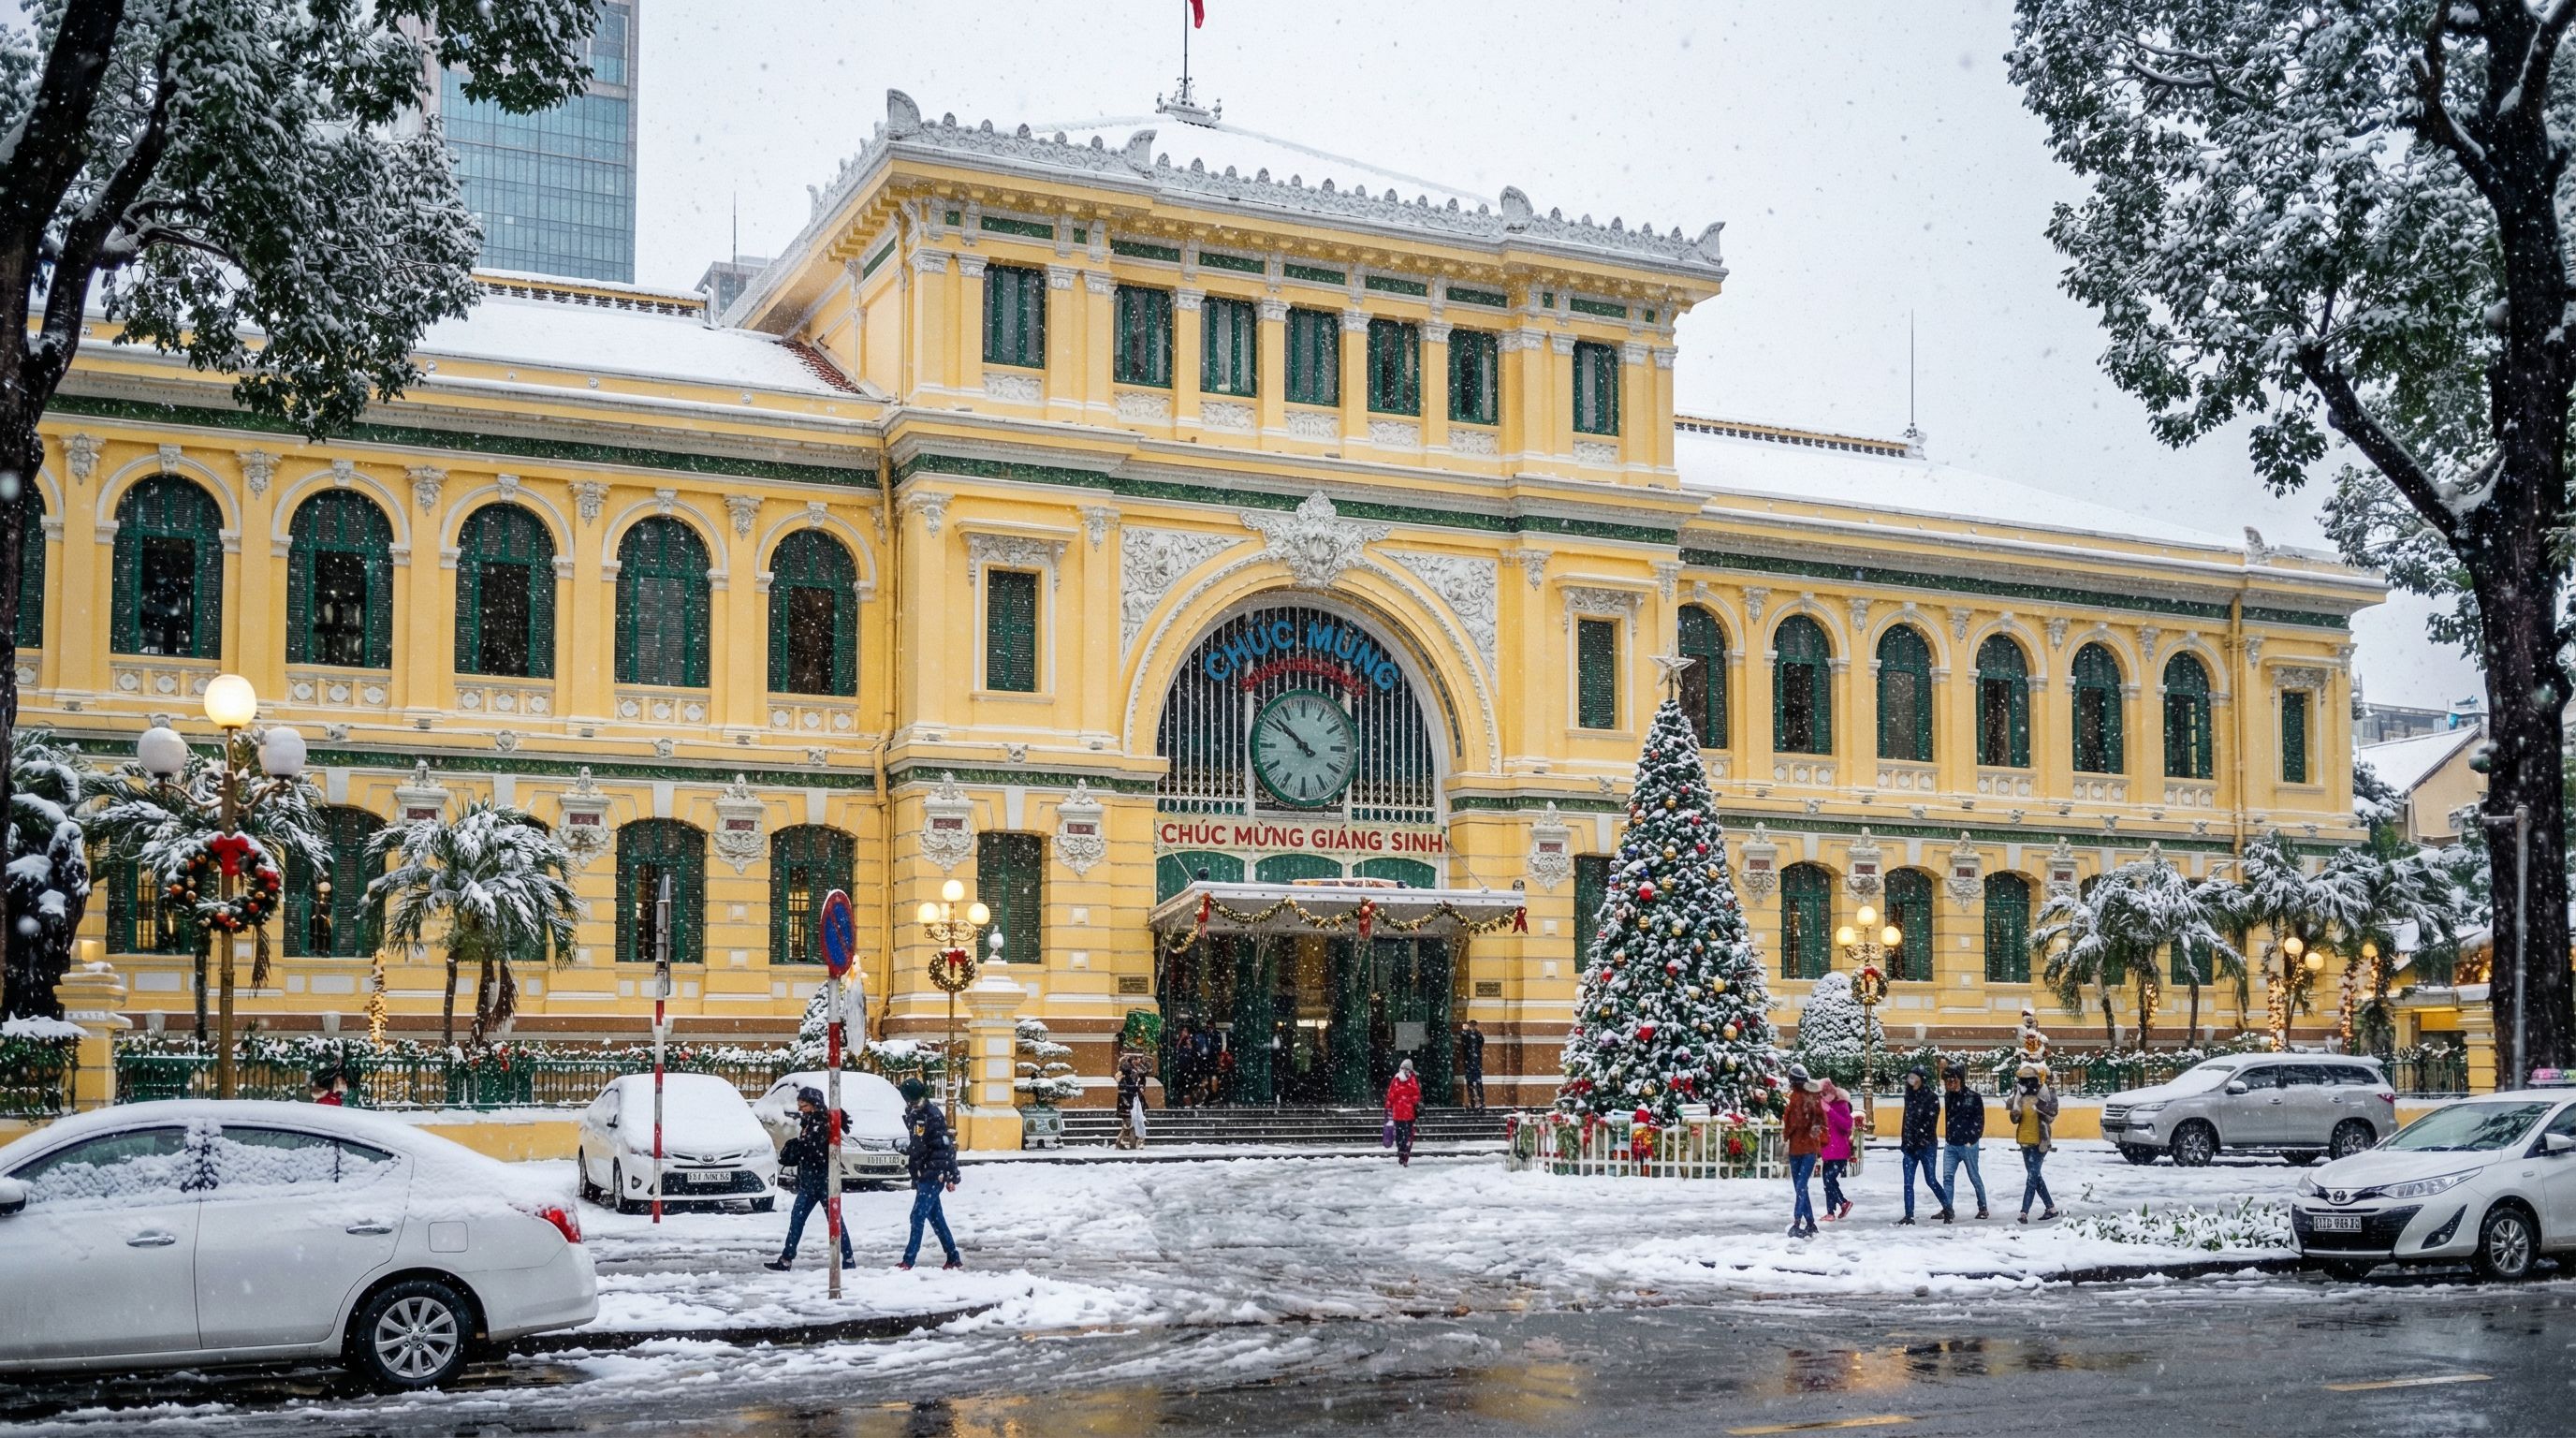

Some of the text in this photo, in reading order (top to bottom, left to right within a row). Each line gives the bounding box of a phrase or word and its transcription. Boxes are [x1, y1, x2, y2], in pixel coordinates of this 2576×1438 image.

[1204, 615, 1295, 682] CHÚC
[1161, 818, 1442, 853] CHÚC MỪNG GIÁNG SINH
